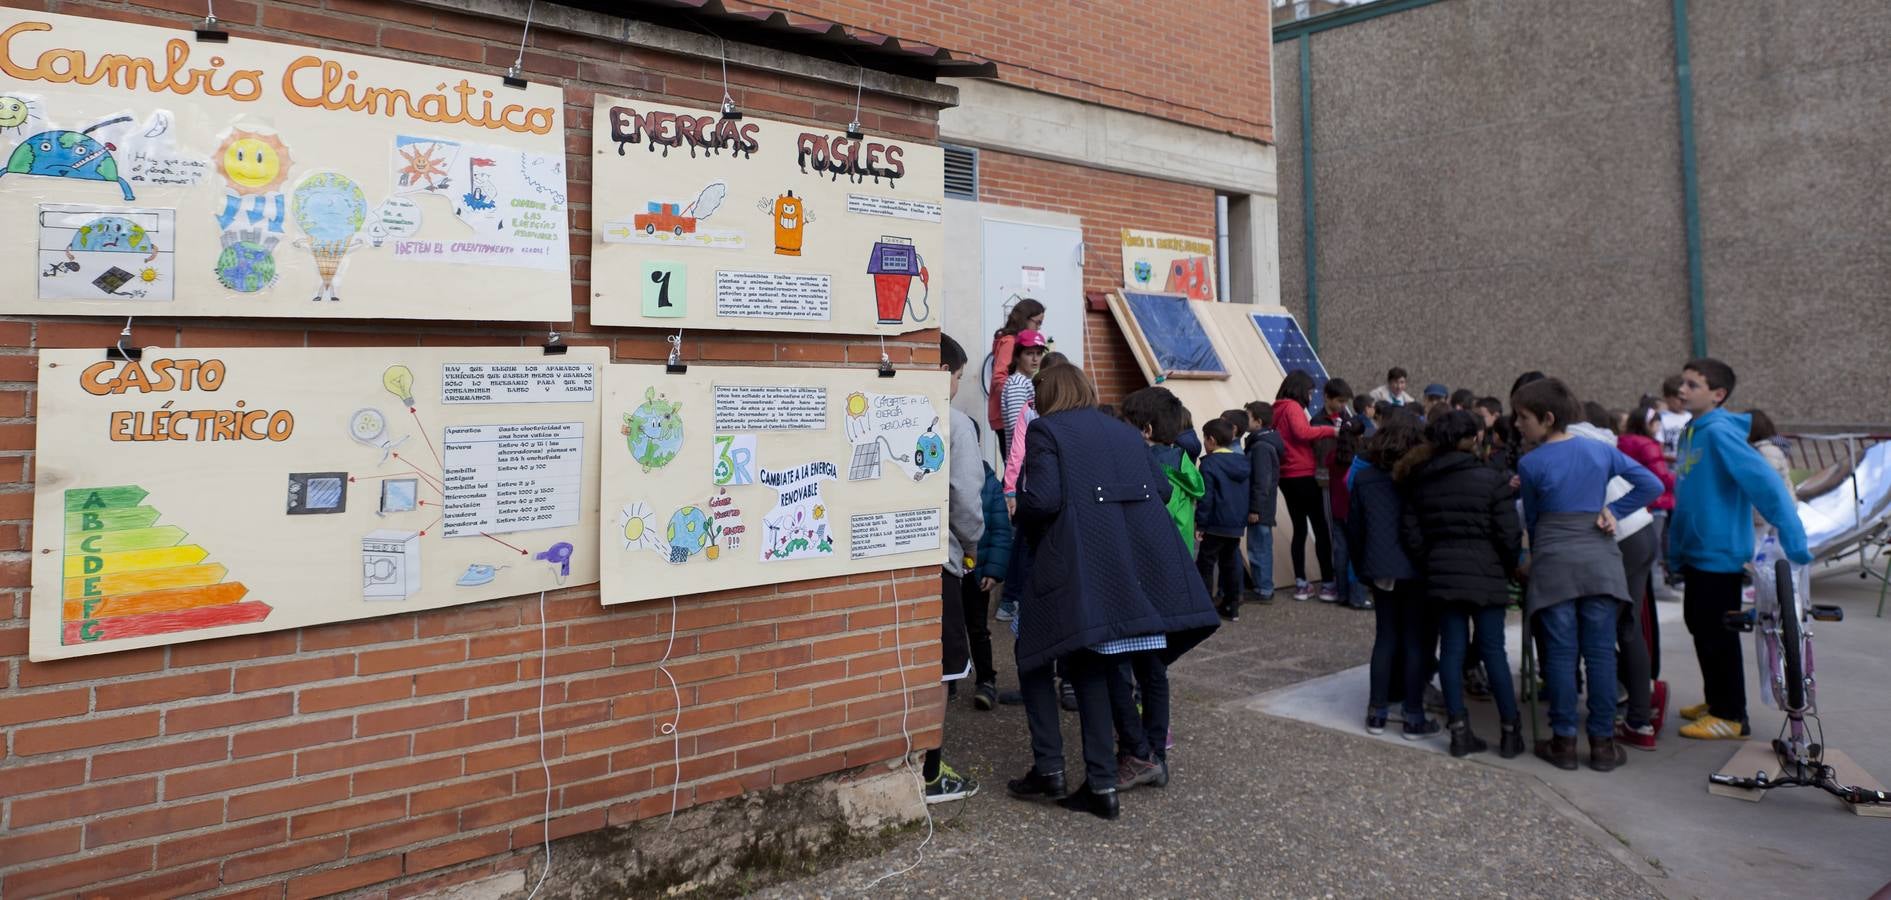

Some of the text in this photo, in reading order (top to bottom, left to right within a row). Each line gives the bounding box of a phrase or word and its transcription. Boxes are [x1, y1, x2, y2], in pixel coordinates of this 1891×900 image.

[0, 22, 555, 134] Cambio Climático
[610, 106, 905, 184] ENERGÍAS FÓSILES
[80, 358, 226, 395] GASTO
[110, 400, 294, 441] ELÉCTRICO
[760, 462, 837, 486] CAMBIATE A LA ENERGIA
[82, 492, 106, 509] A
[780, 483, 818, 506] RENOVABLE
[82, 513, 104, 531] B
[81, 535, 102, 552] C
[84, 556, 103, 574] D
[84, 577, 102, 596] E
[84, 598, 102, 619] F
[80, 619, 104, 641] G
